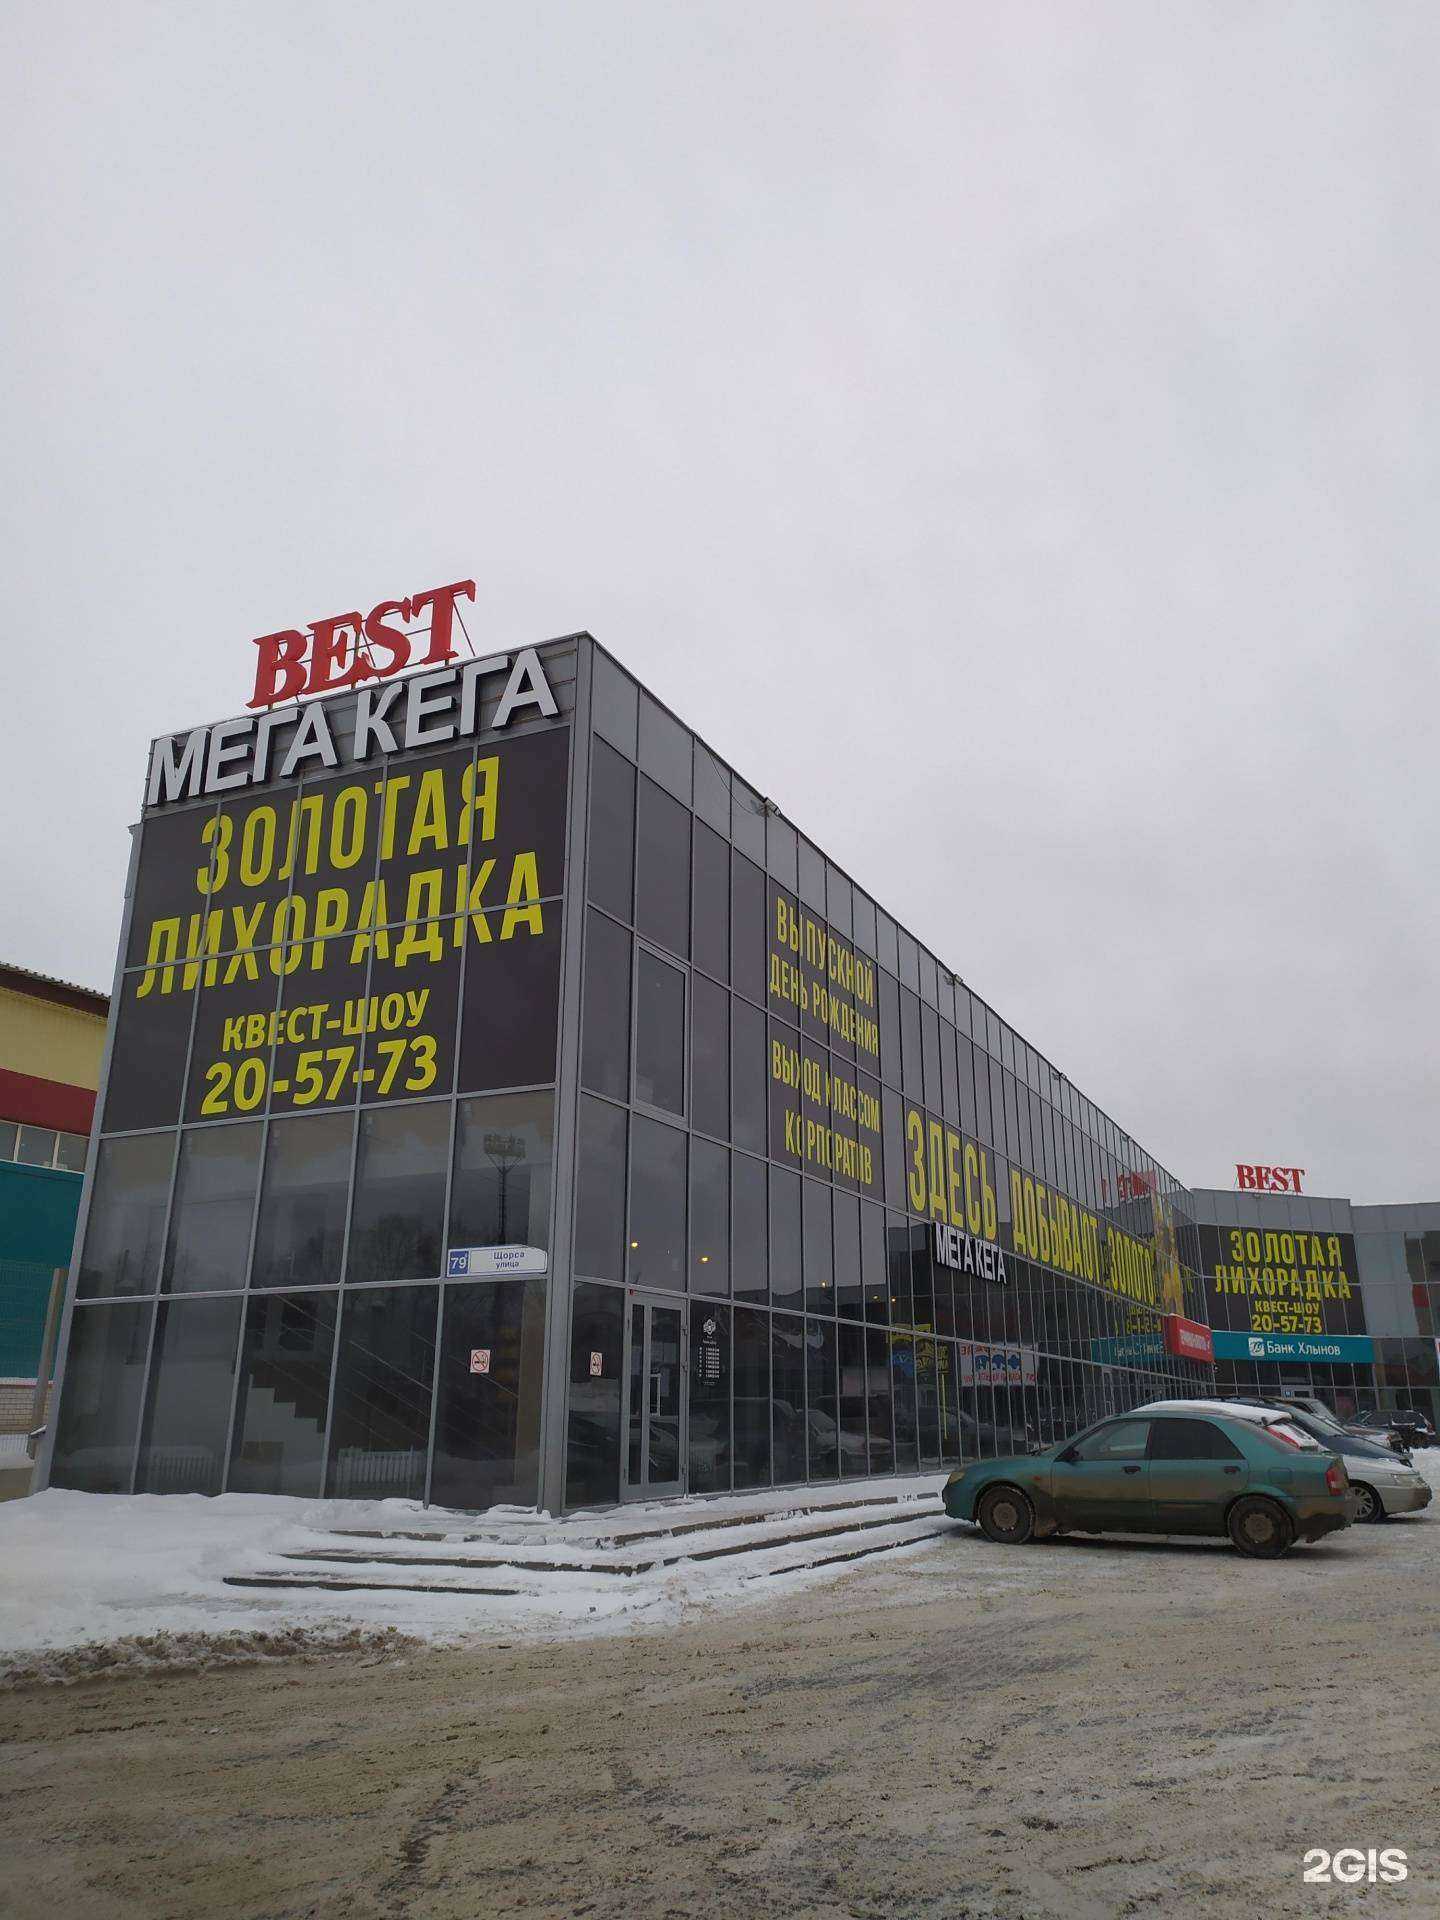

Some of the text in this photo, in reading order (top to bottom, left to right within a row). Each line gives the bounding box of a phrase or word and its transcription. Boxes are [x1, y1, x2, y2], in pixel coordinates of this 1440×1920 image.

[246, 579, 476, 708] BEST
[147, 648, 560, 807] МЕГА КЕГА
[196, 756, 500, 895] ЗОЛОТАЯ
[136, 851, 544, 998] ЛИХОРАДКА
[777, 896, 874, 1008] ВЫПУСКНОЙ
[222, 989, 430, 1051] КВЕСТ-ШОУ
[769, 953, 879, 1056] ДЕНЬ РОЖДЕНИЯ
[201, 1036, 437, 1115] 20-57-73
[907, 1110, 997, 1241] ЗДЕСЬ
[1011, 1169, 1101, 1284] ДОБЫВАЮТ
[1235, 1164, 1306, 1194] BEST
[493, 1250, 526, 1261] Щорса
[495, 1261, 520, 1270] улица
[935, 1221, 1008, 1284] МЕГА КЕГА
[1230, 1231, 1342, 1267] ЗОЛОТАЯ
[1215, 1264, 1352, 1301] ЛИХОРАДКА
[1254, 1300, 1320, 1314] КВЕСТ-ШОУ
[1251, 1314, 1323, 1334] 20-57-73
[1267, 1340, 1341, 1356] Банк Хлынов
